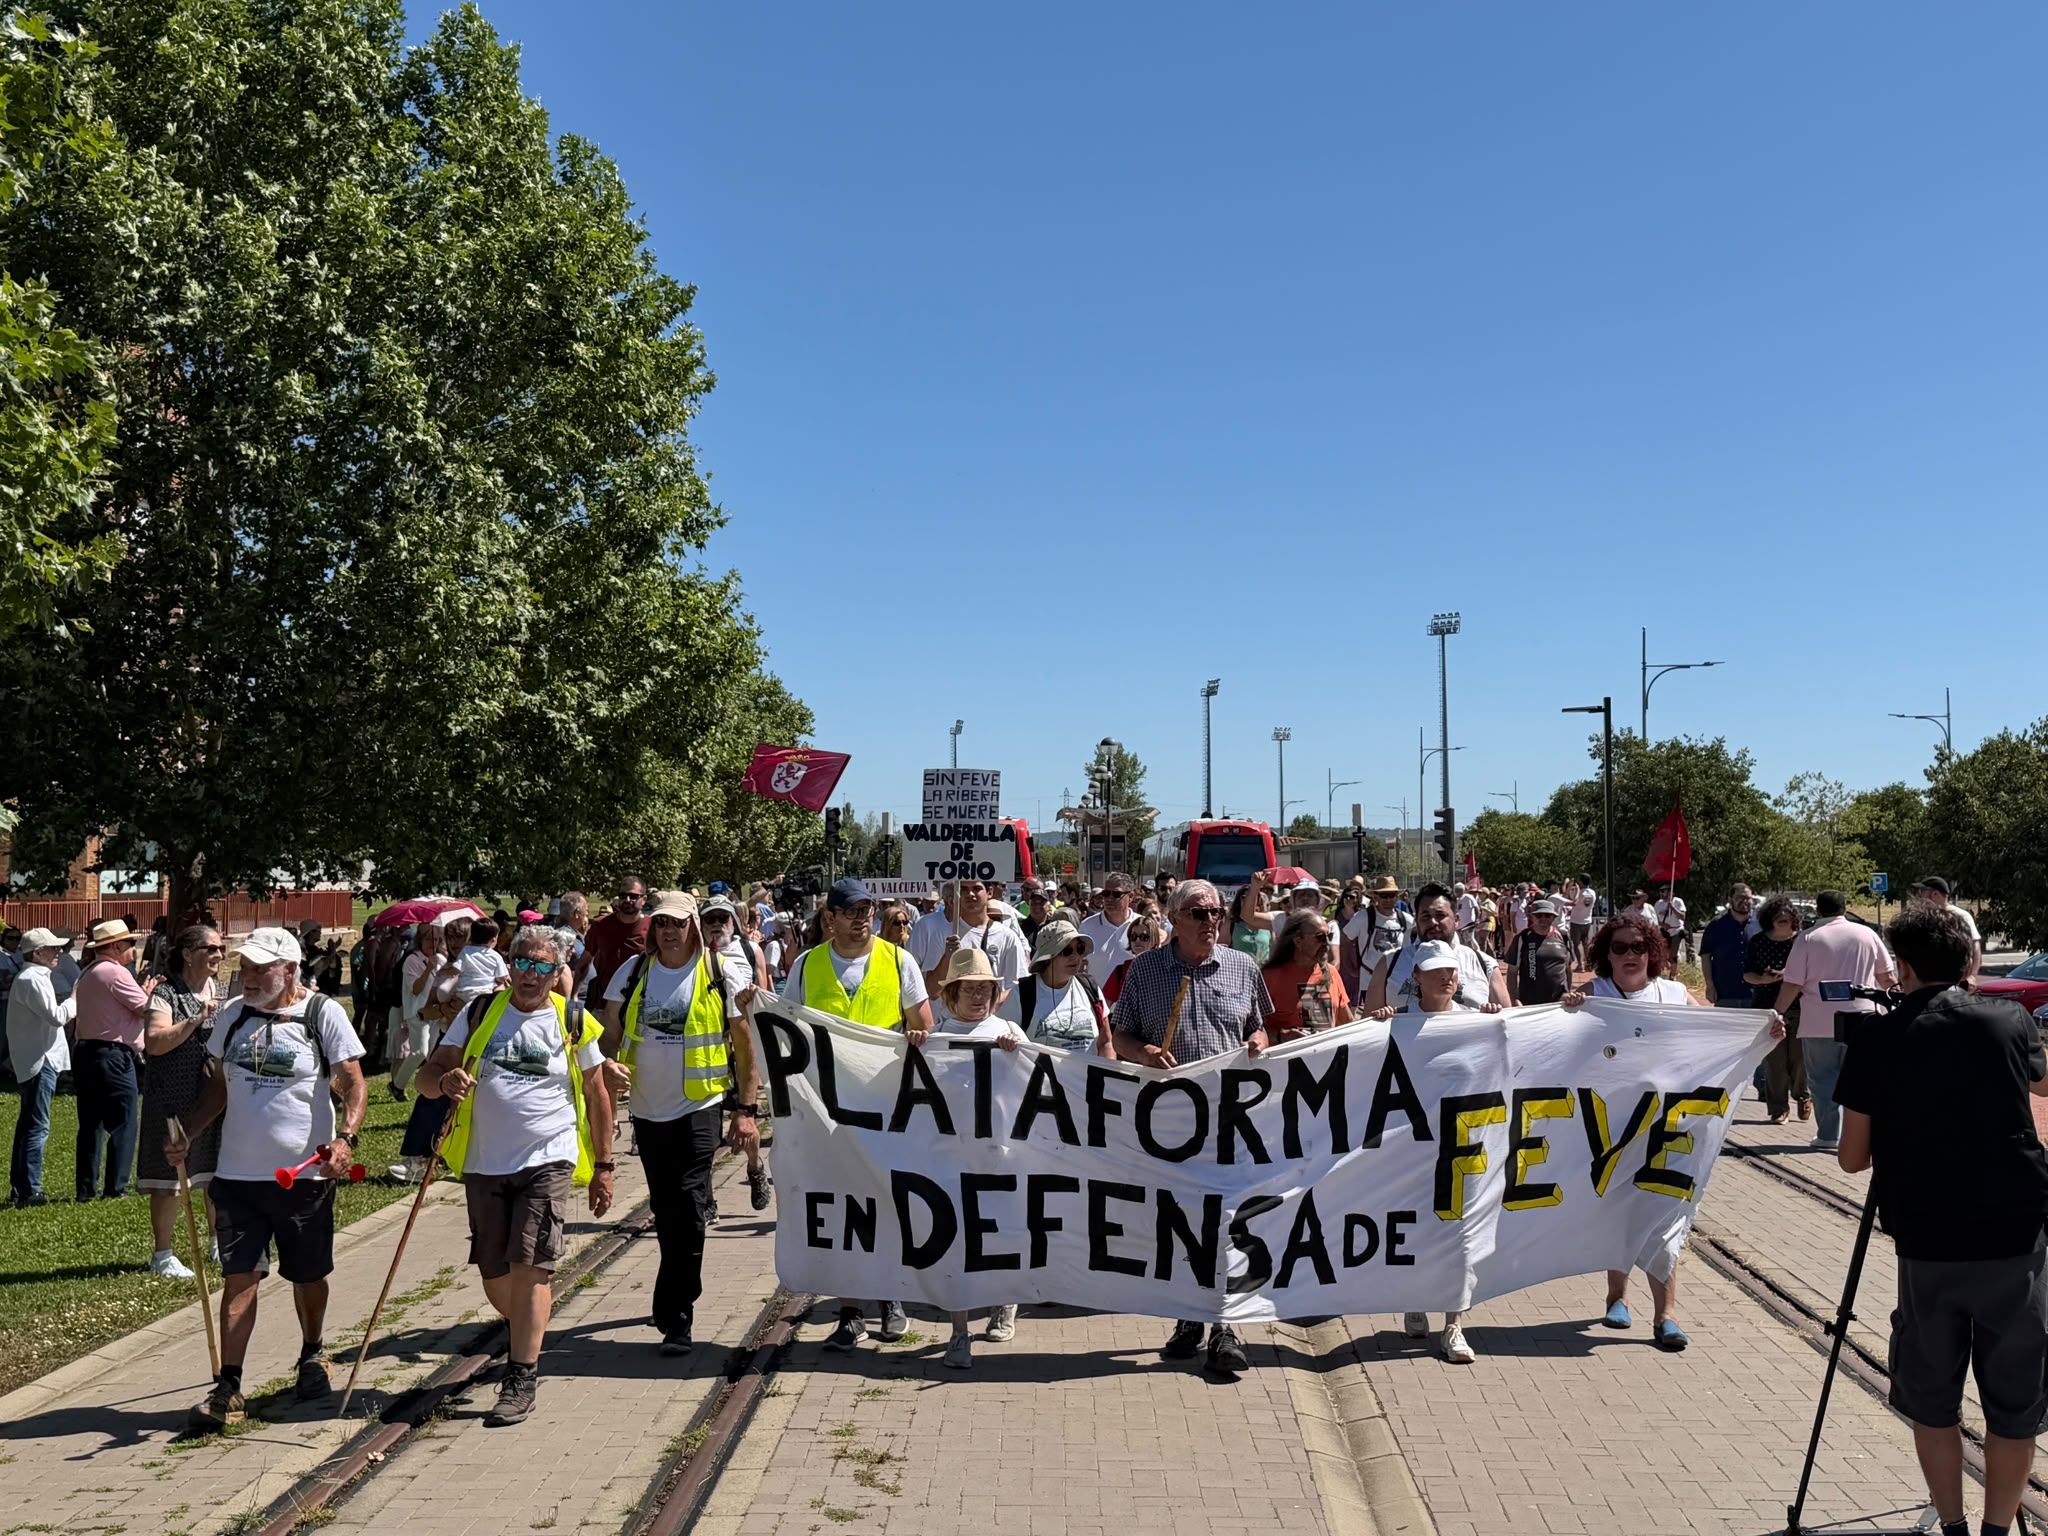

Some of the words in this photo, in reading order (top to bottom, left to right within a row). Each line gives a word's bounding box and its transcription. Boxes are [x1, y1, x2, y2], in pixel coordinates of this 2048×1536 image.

[960, 773, 1000, 787] FEVE
[923, 790, 942, 802] LA
[923, 806, 944, 819] SE
[948, 805, 999, 819] MUERE
[903, 823, 1015, 842] VALDERILLA
[951, 843, 974, 861] DE
[925, 861, 995, 880] TORIO
[881, 881, 928, 894] VALCUEVA
[754, 1011, 1435, 1165] PLATAFORMA
[805, 1191, 877, 1253] EN
[890, 1168, 1338, 1295] DEFENSA
[1343, 1209, 1417, 1268] DE
[1433, 1086, 1731, 1221] FEVE
